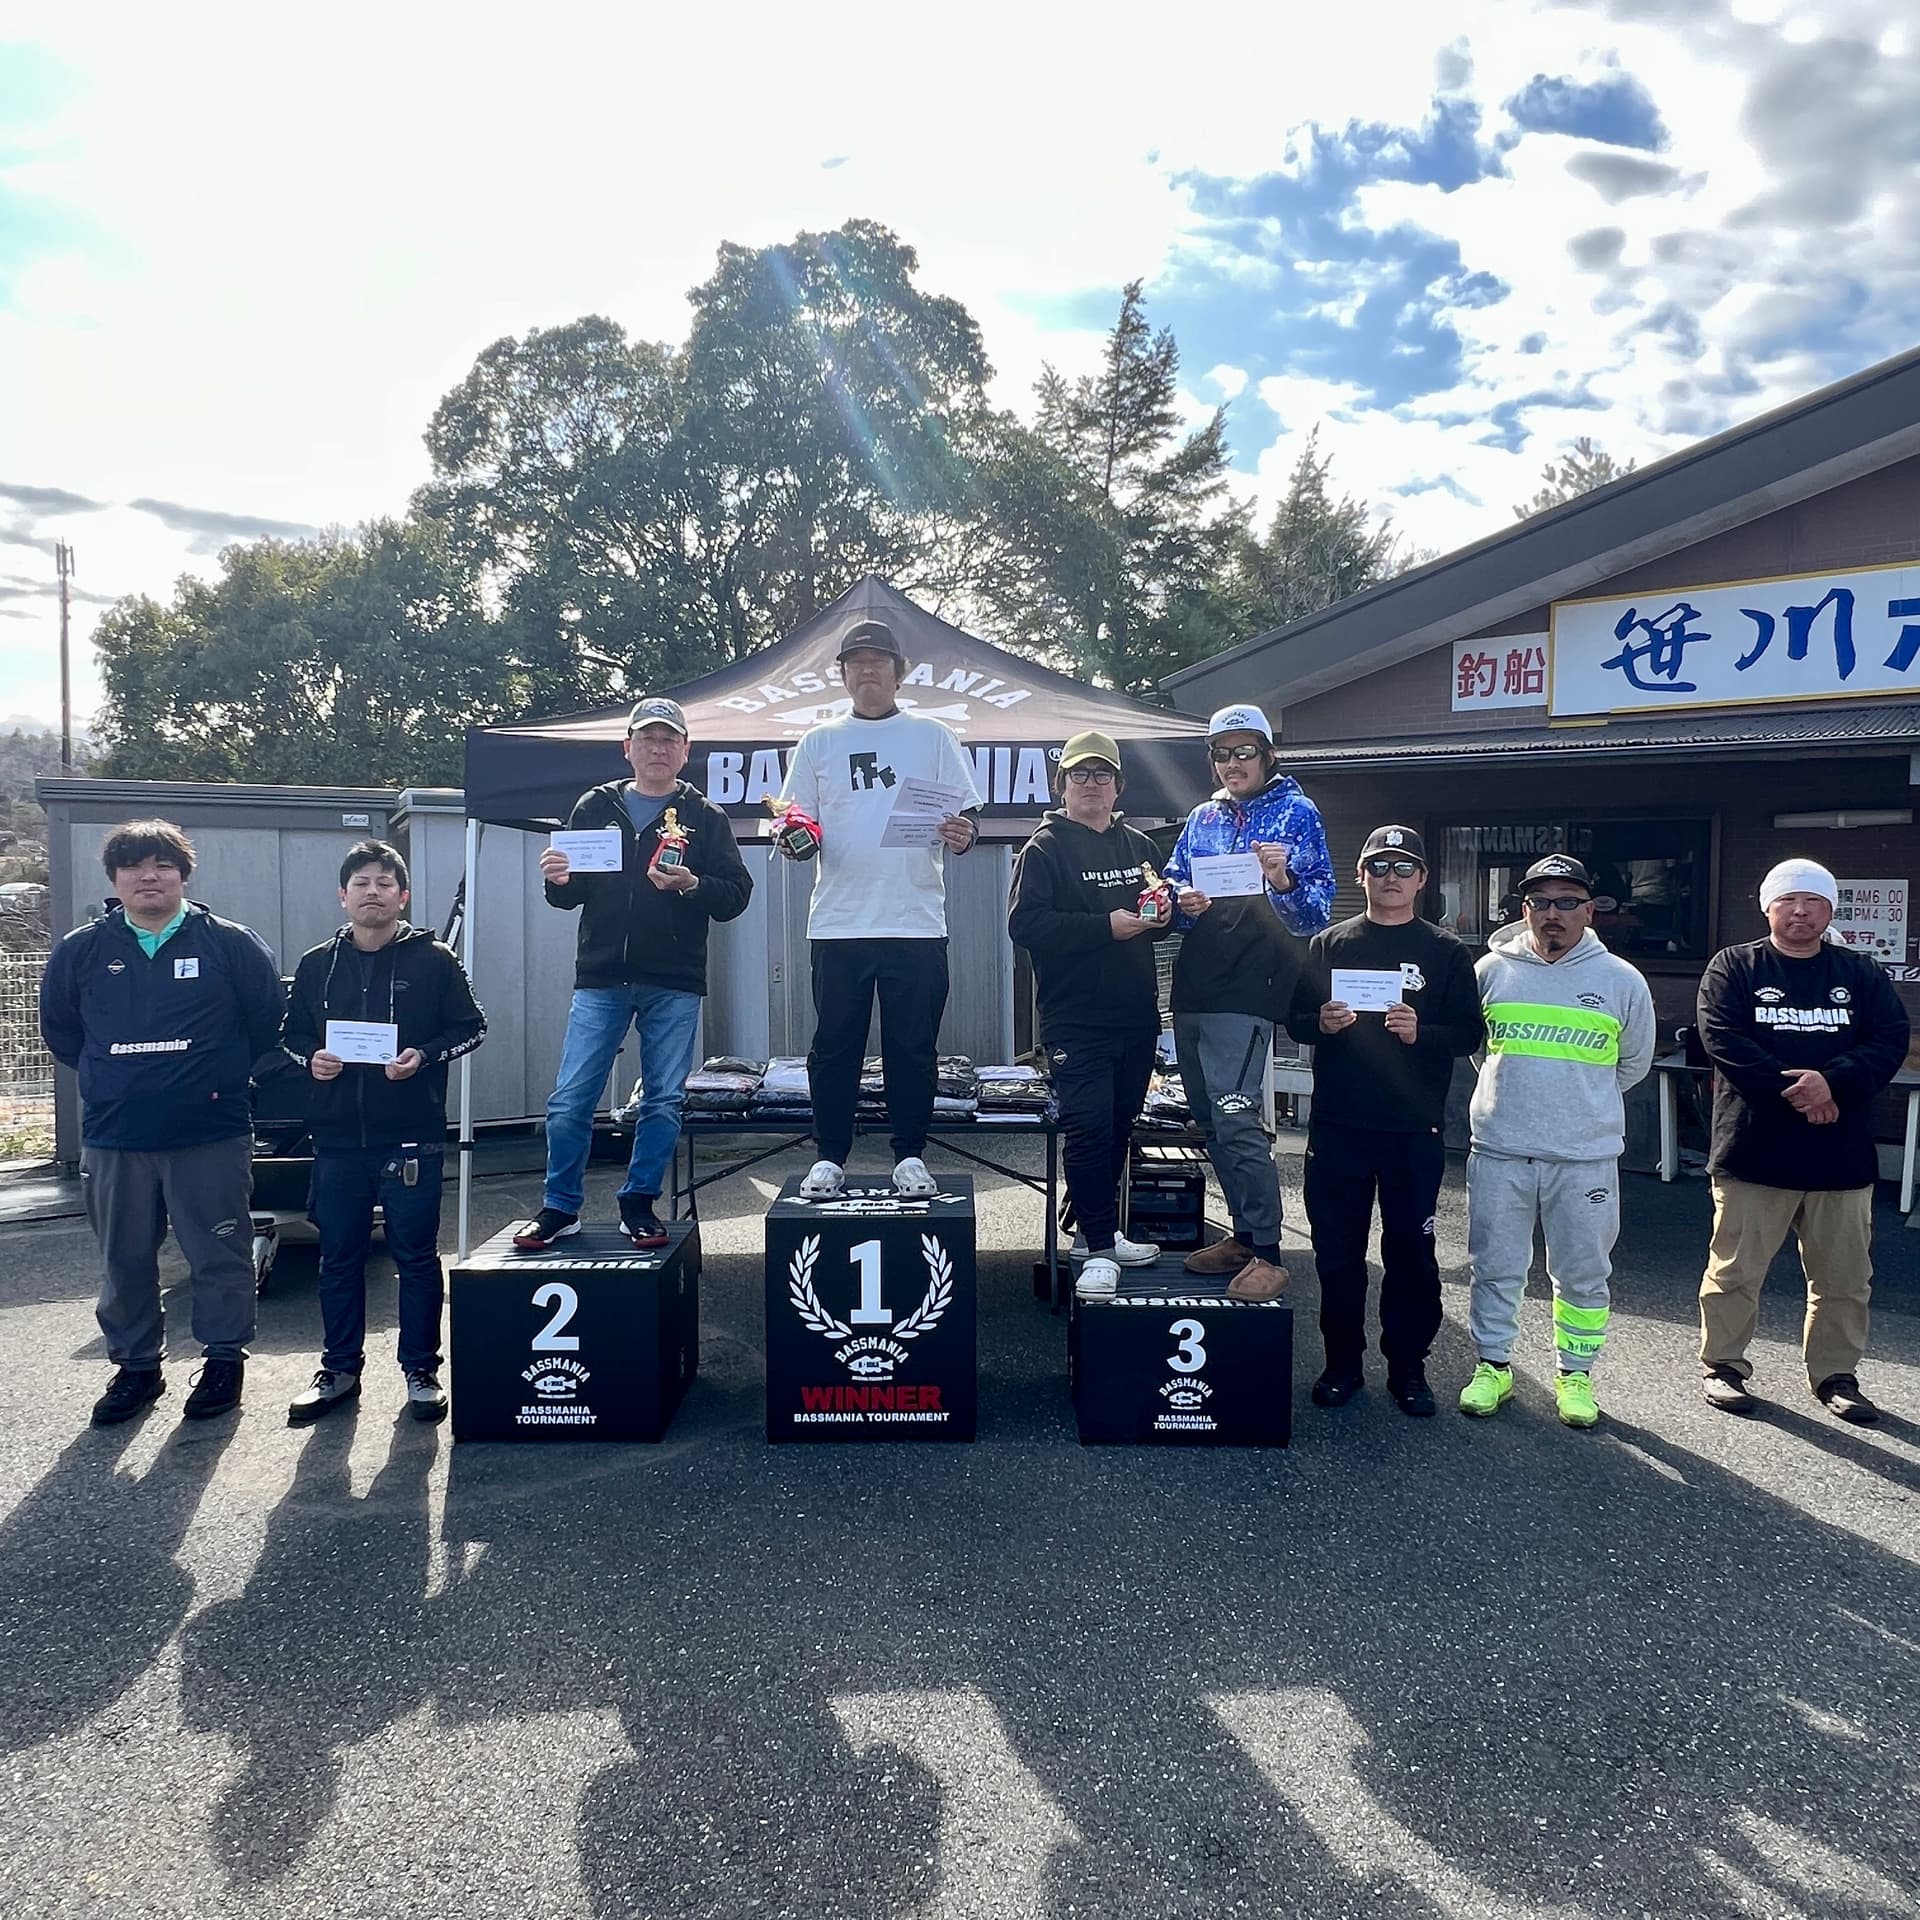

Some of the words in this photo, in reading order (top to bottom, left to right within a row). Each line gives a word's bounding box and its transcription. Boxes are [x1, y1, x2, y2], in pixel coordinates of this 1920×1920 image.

[1457, 647, 1545, 699] 釣船
[715, 663, 1032, 714] BASSANIA
[1755, 1007, 1850, 1025] BASSMANIA
[850, 1239, 892, 1324] 1
[531, 1282, 580, 1351] 2
[834, 1336, 909, 1363] BASSMANIA
[1166, 1318, 1207, 1373] 3
[521, 1357, 591, 1383] BASSMANIA
[801, 1386, 942, 1410] WINNER
[1159, 1377, 1213, 1398] BASSMANIA
[515, 1415, 597, 1424] TOURNAMENT
[521, 1405, 591, 1415] BASSMANIA
[794, 1412, 864, 1423] BASSMANIA
[867, 1412, 950, 1422] TOURNAMENT
[1158, 1414, 1212, 1423] BASSMANIA
[1153, 1422, 1218, 1430] TOURNAMENT
